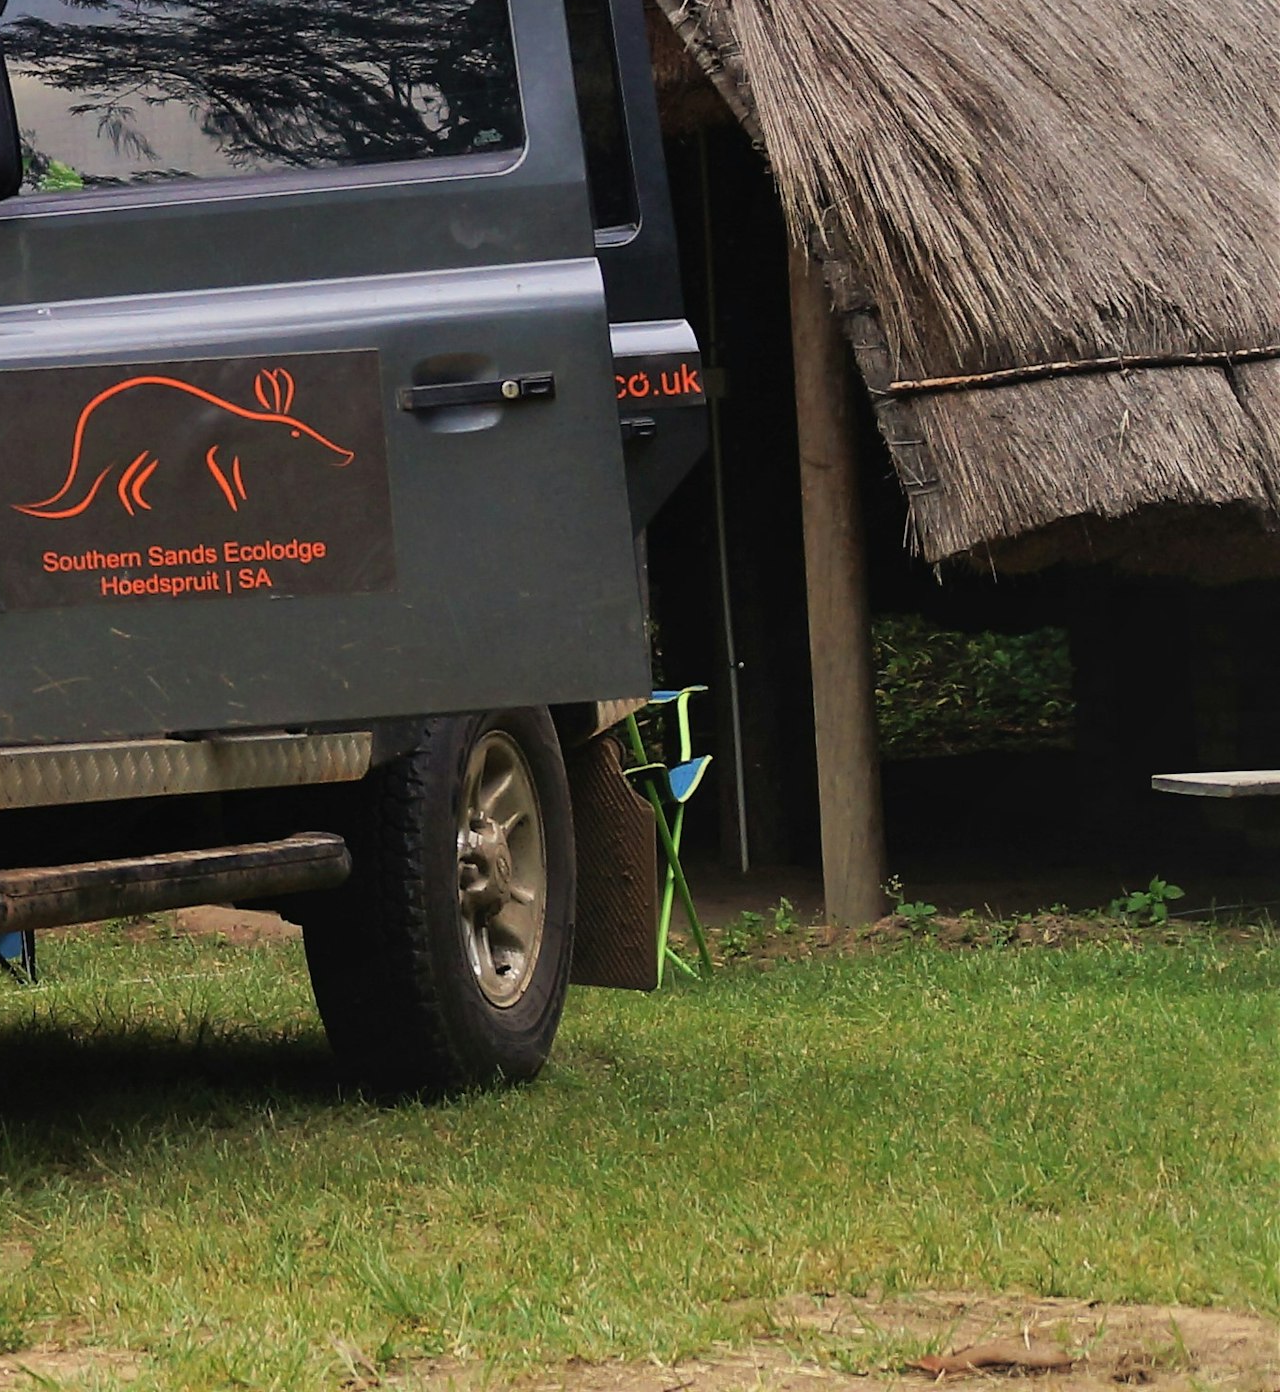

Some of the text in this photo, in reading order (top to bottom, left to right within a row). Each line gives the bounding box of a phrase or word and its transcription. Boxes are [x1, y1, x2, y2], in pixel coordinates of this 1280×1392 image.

[42, 538, 327, 572] Southern Sands Ecolodge
[100, 572, 220, 597] Hoedspruit
[238, 566, 273, 590] SA
